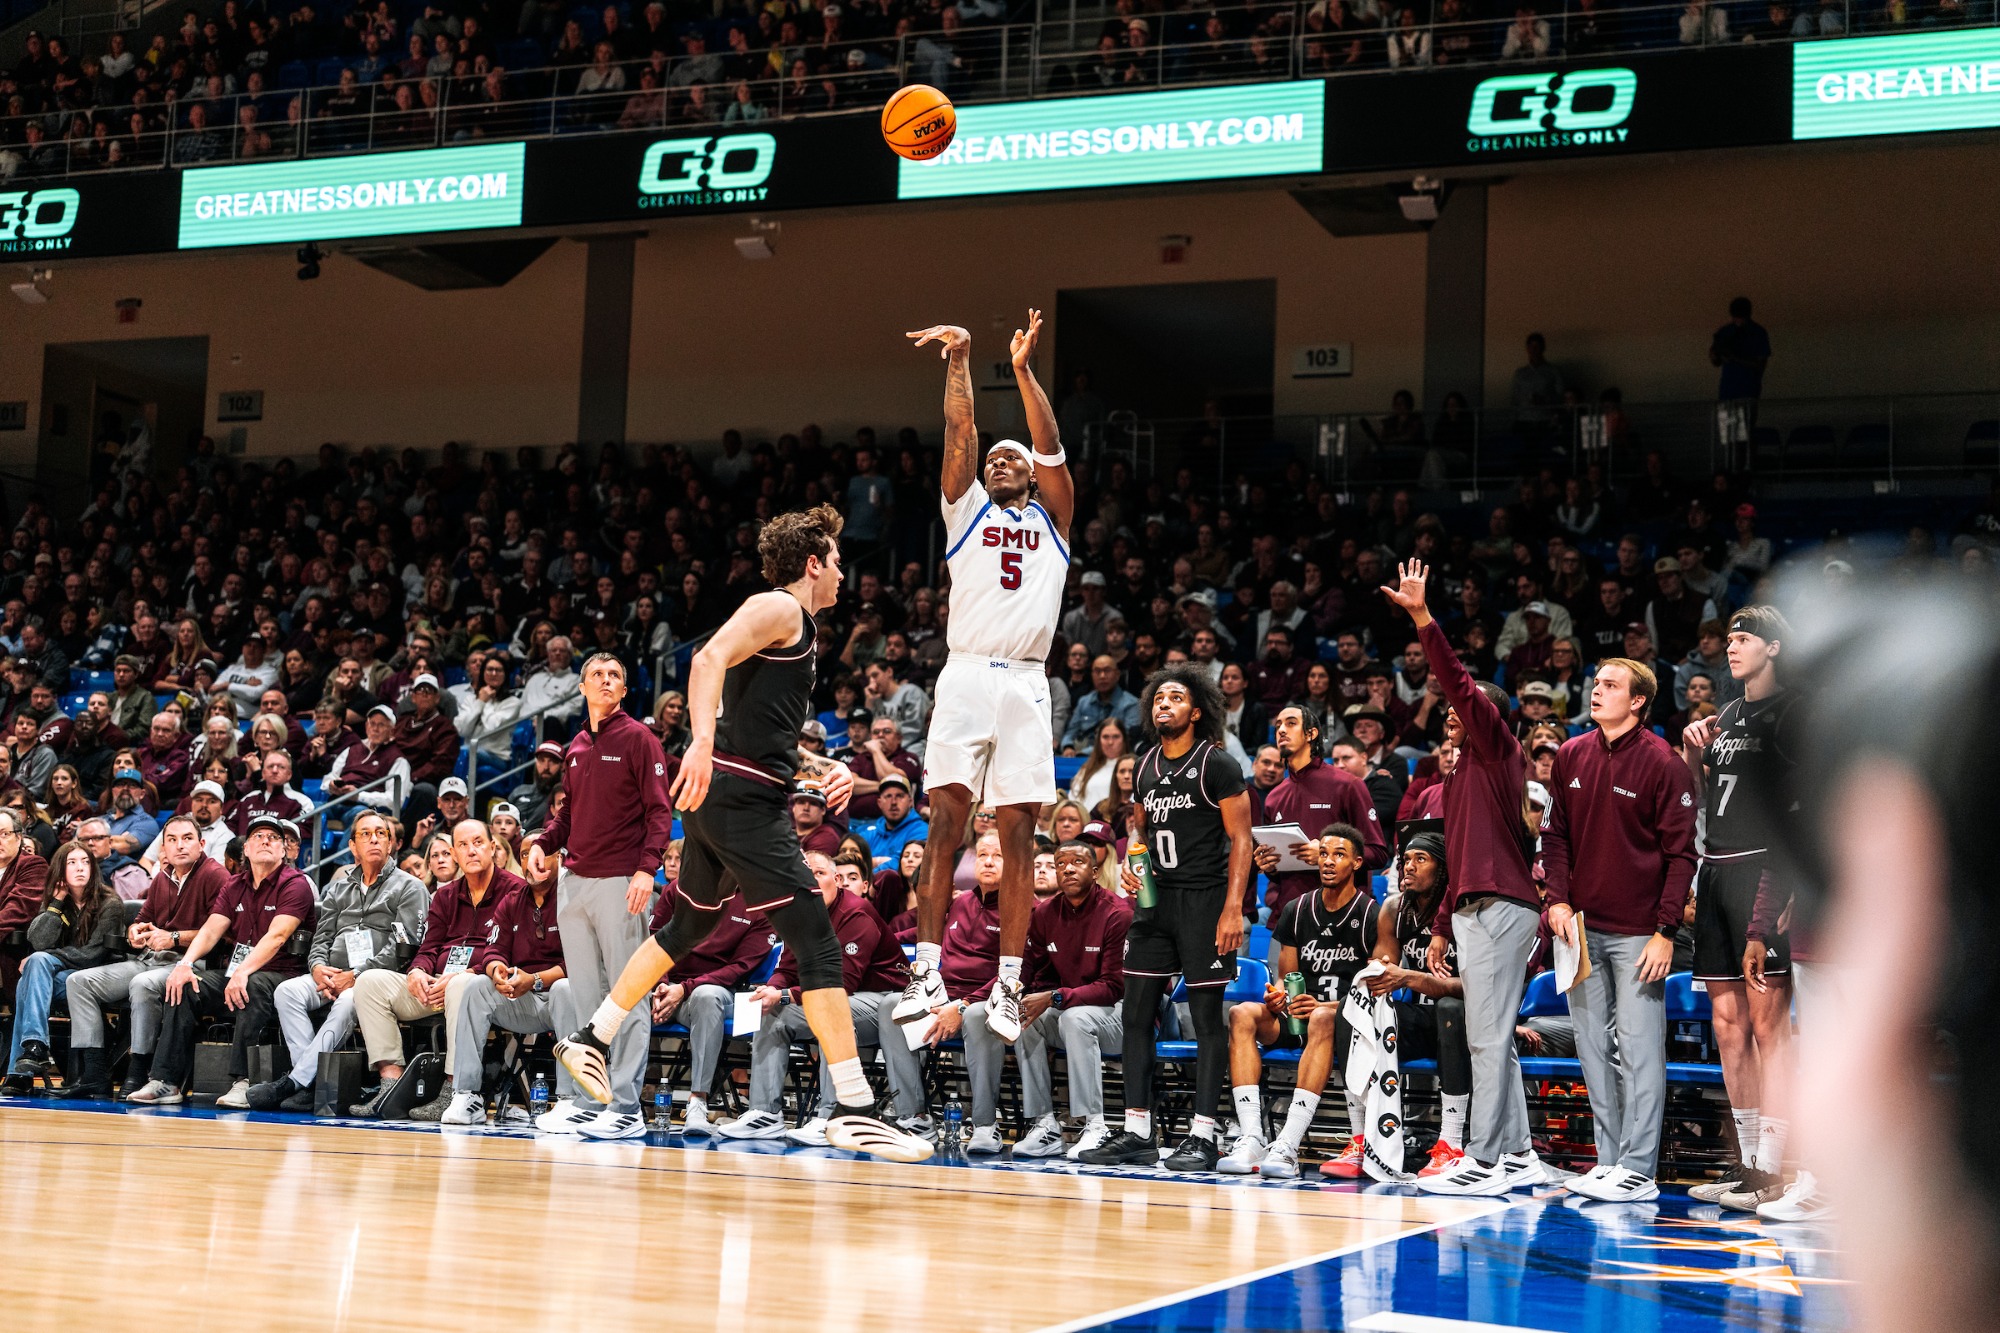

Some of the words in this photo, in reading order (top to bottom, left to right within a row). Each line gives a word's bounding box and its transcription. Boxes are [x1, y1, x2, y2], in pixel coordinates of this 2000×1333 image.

[1816, 62, 2000, 103] GREATNE
[914, 116, 946, 139] NCAA
[195, 172, 508, 220] GREATNESSONLY.COM
[993, 361, 1013, 379] 10
[1306, 349, 1339, 367] 103
[229, 395, 254, 412] 102
[982, 526, 1040, 551] SMU
[1000, 551, 1022, 590] 5
[989, 661, 1009, 669] SMU
[1711, 730, 1762, 766] Aggies
[1143, 789, 1196, 823] Aggies
[1717, 773, 1738, 817] 7
[1155, 829, 1178, 869] 0
[1300, 939, 1359, 972] Aggies
[1317, 975, 1339, 1001] 3
